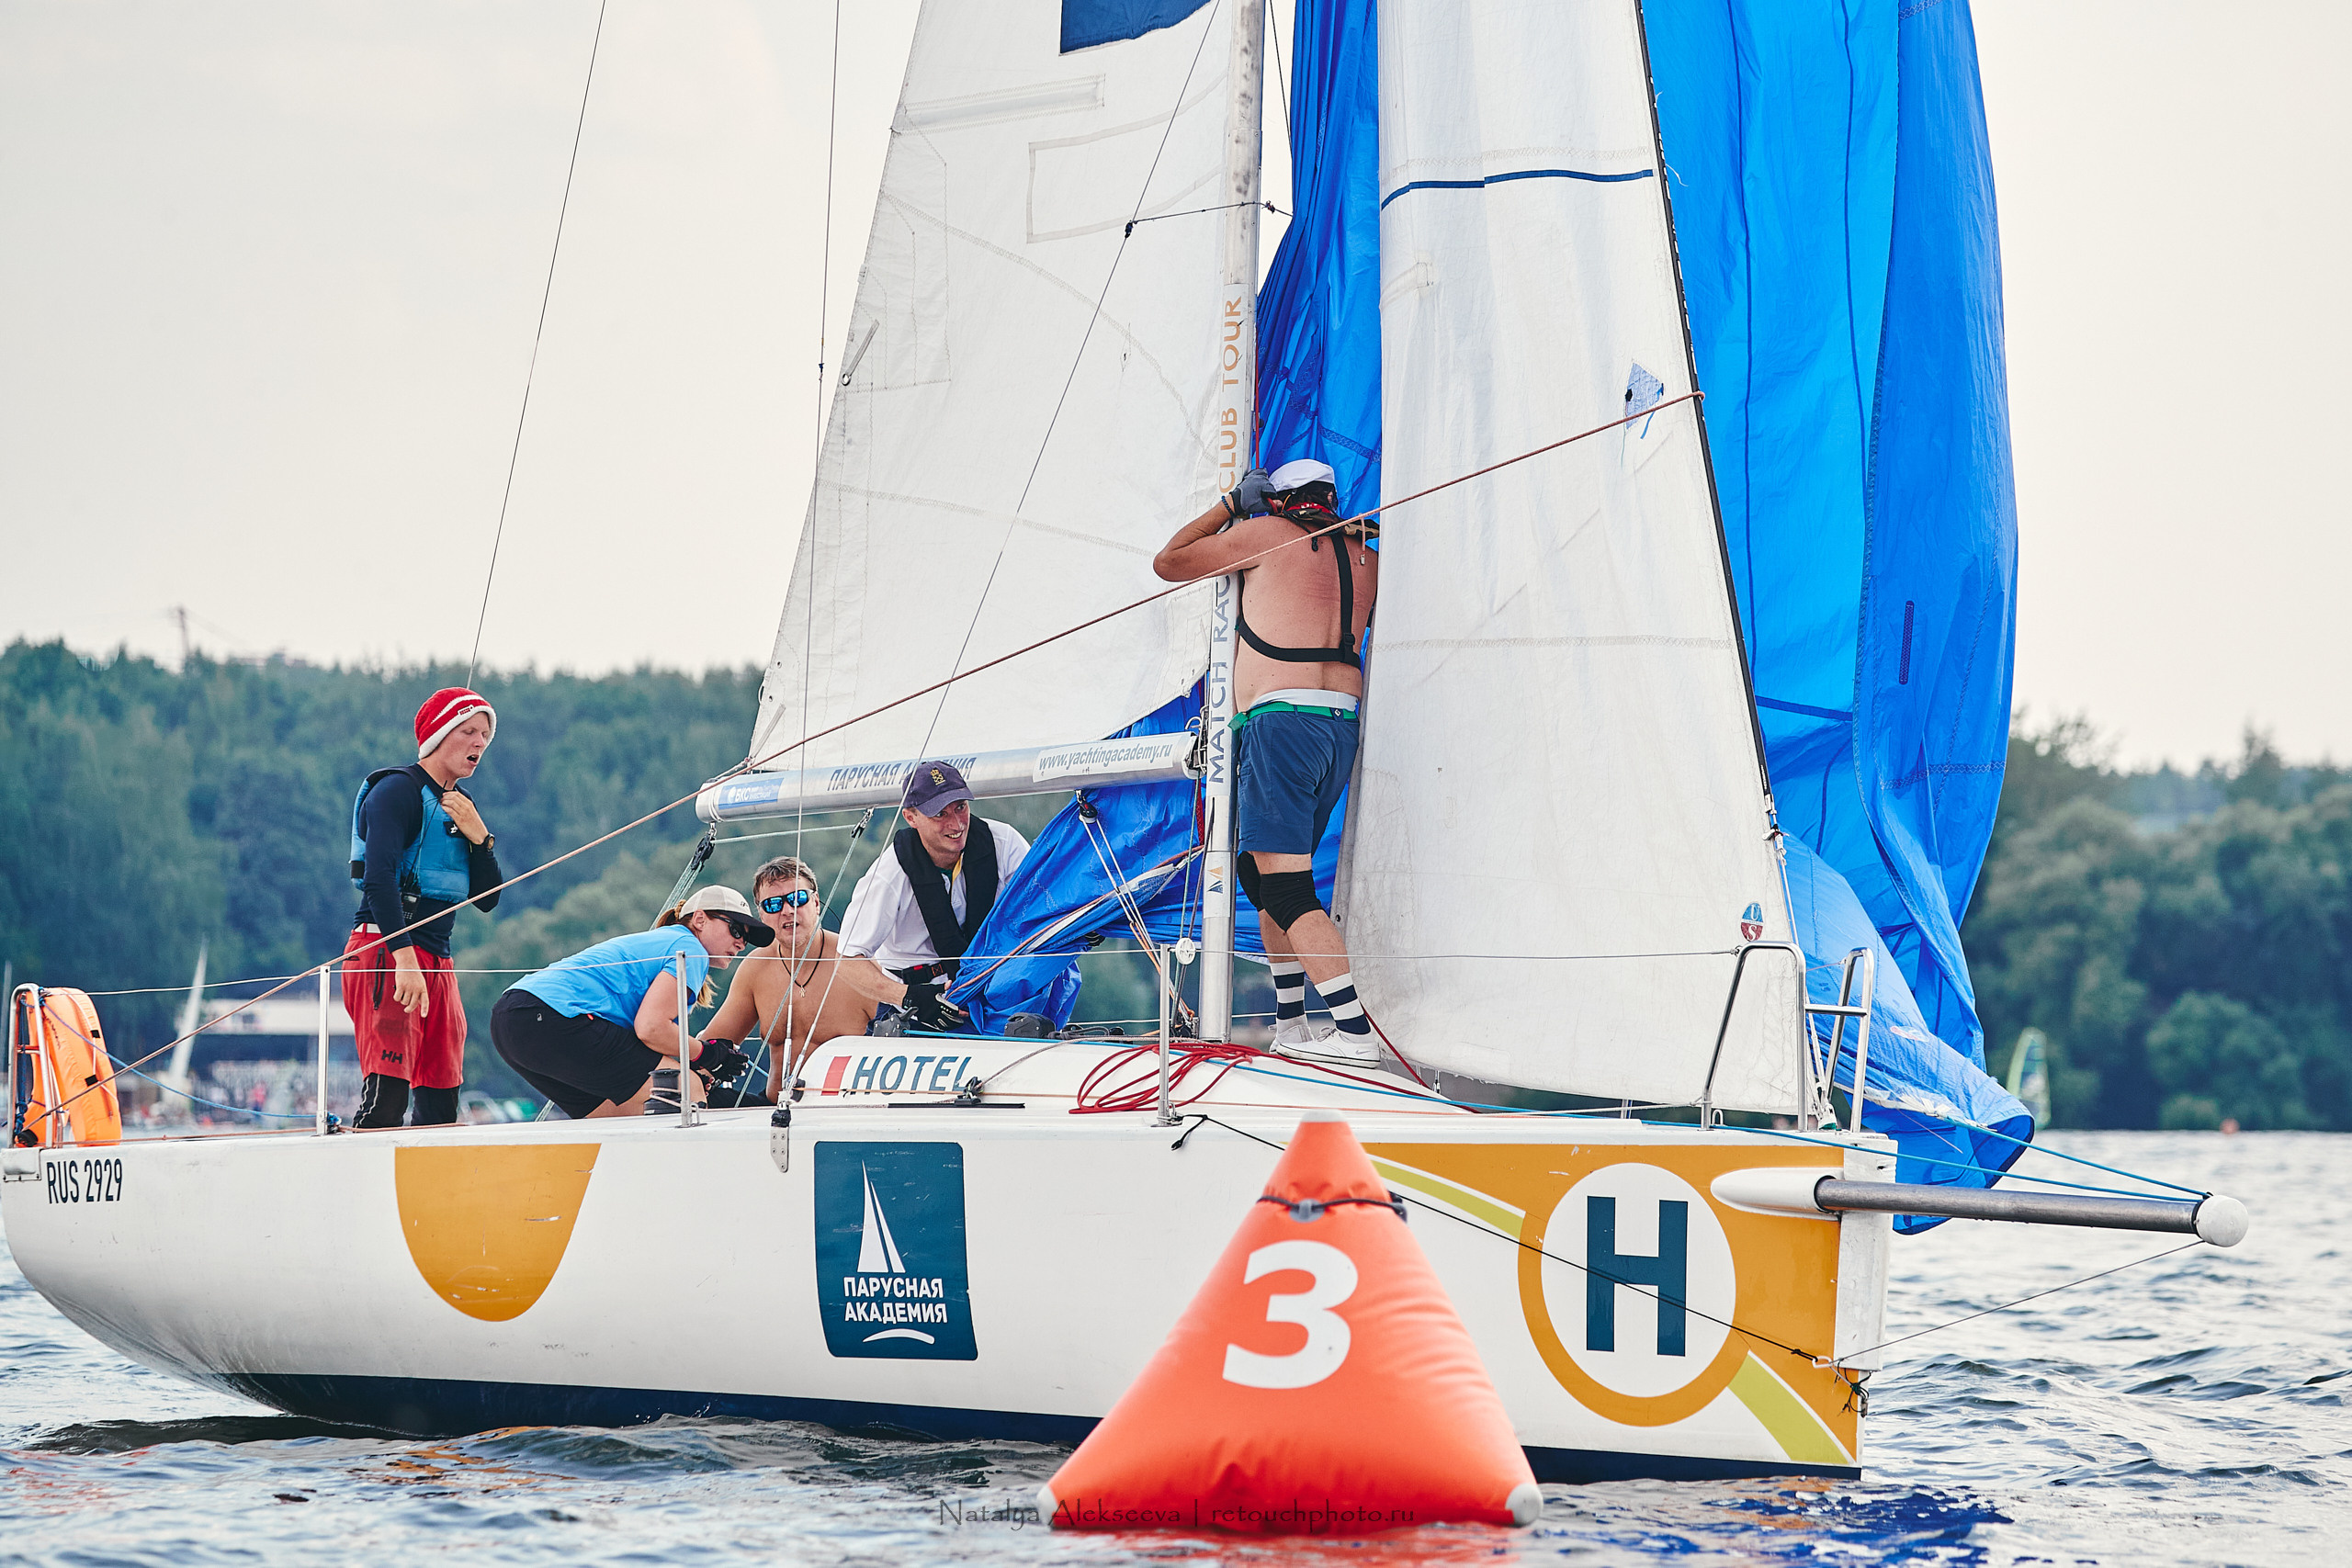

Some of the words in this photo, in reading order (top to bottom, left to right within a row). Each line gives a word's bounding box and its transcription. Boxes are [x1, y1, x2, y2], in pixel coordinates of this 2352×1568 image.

[1221, 295, 1242, 393] TOUR
[1218, 407, 1238, 494] CLUB
[1212, 574, 1231, 643] RAC
[1209, 661, 1227, 784] MATCH
[827, 762, 902, 792] ПАРУСНАЯ
[1039, 742, 1173, 771] www.yachtingacademy.ru
[381, 1049, 403, 1065] HH
[850, 1055, 972, 1096] HOTEL
[46, 1160, 80, 1204] RUS
[84, 1158, 122, 1202] 2929
[843, 1277, 944, 1298] ПАРУСНАЯ
[1587, 1196, 1689, 1357] H
[844, 1302, 948, 1325] АКАДЕМИЯ
[1223, 1240, 1358, 1390] 3
